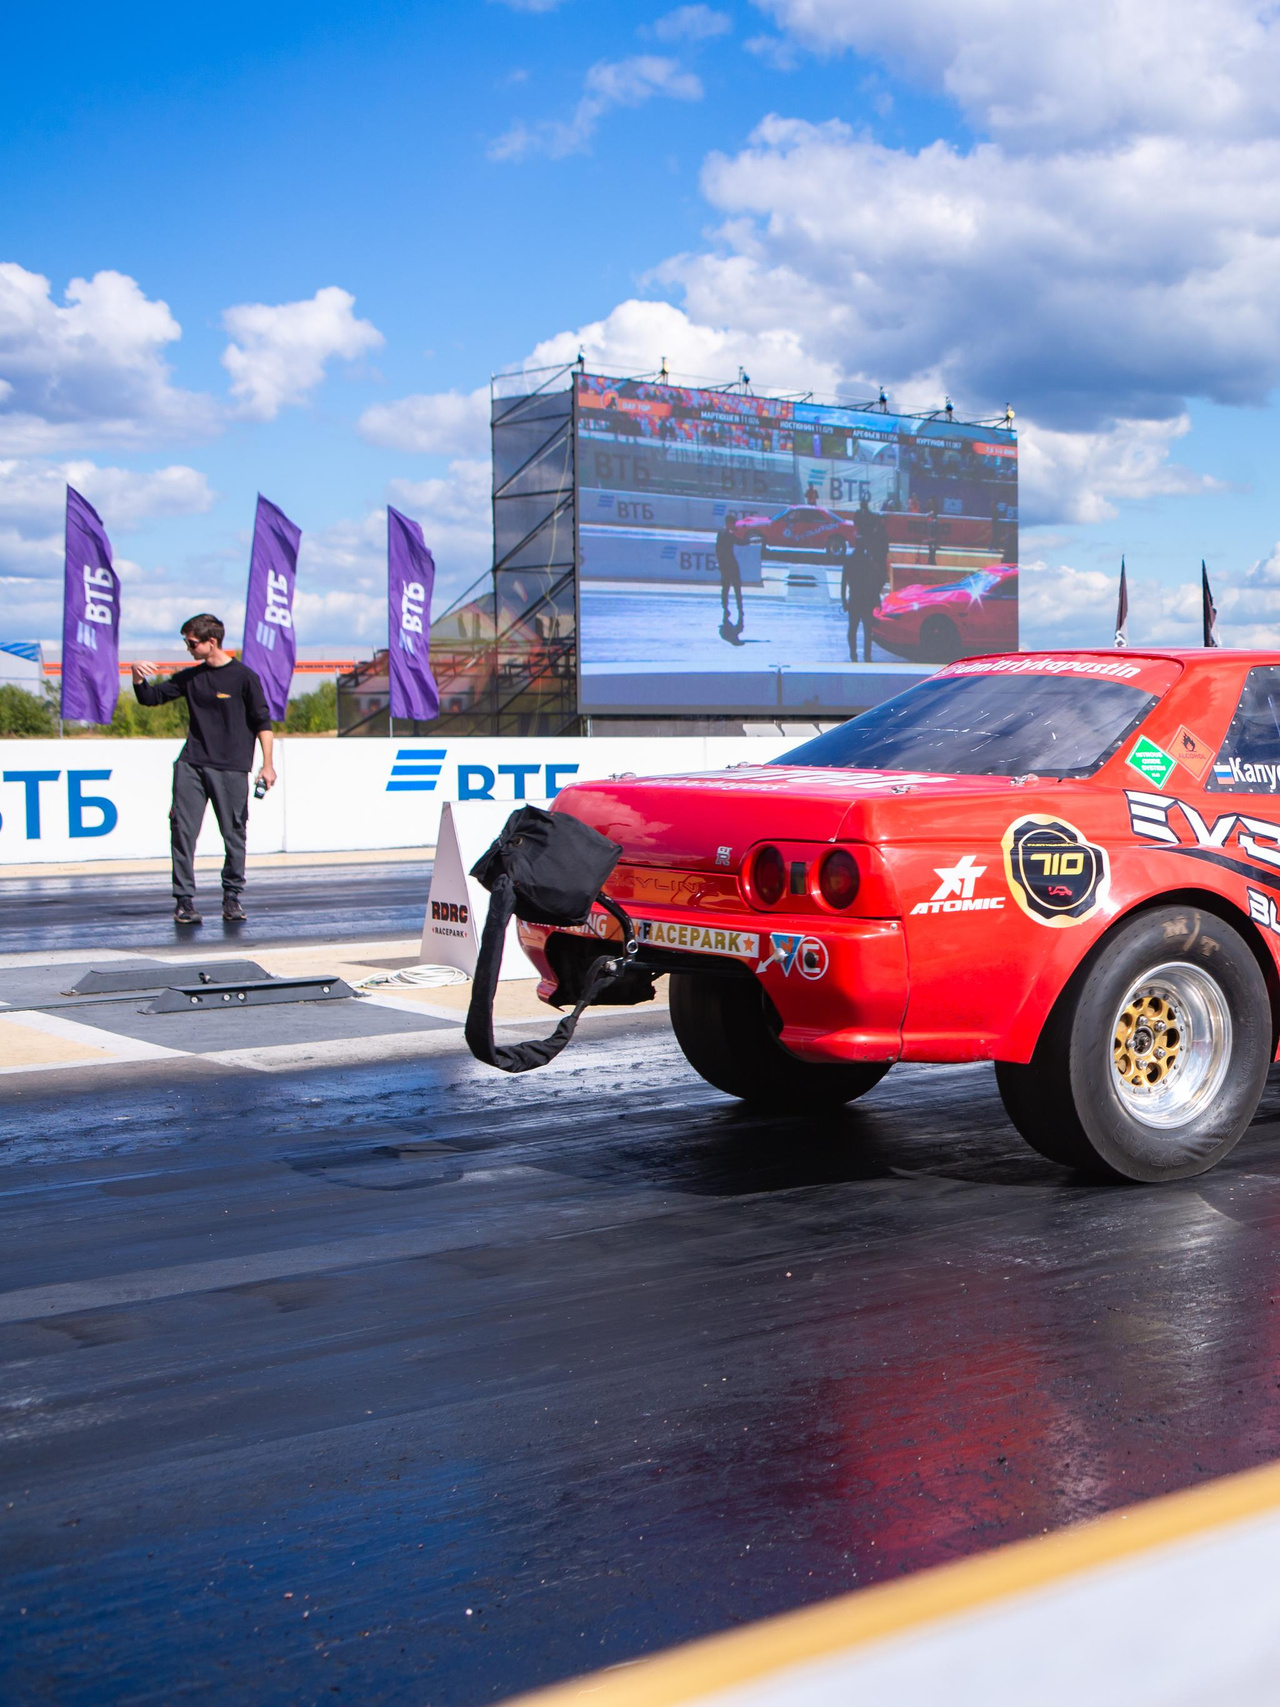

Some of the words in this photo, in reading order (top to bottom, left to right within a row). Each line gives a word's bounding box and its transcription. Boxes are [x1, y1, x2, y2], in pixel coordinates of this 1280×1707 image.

[595, 451, 649, 481] ВТБ
[829, 477, 872, 503] ВТБ
[617, 501, 655, 521] ВТБ
[84, 564, 115, 626] ВТБ
[264, 568, 293, 629] ВТБ
[401, 580, 426, 635] ВТБ
[0, 769, 119, 840] ТБ
[1030, 852, 1085, 876] 710
[431, 900, 468, 925] RDRC
[909, 896, 1007, 916] ATOMIC
[434, 926, 465, 939] RACEPARK
[643, 921, 742, 953] RACEPARK
